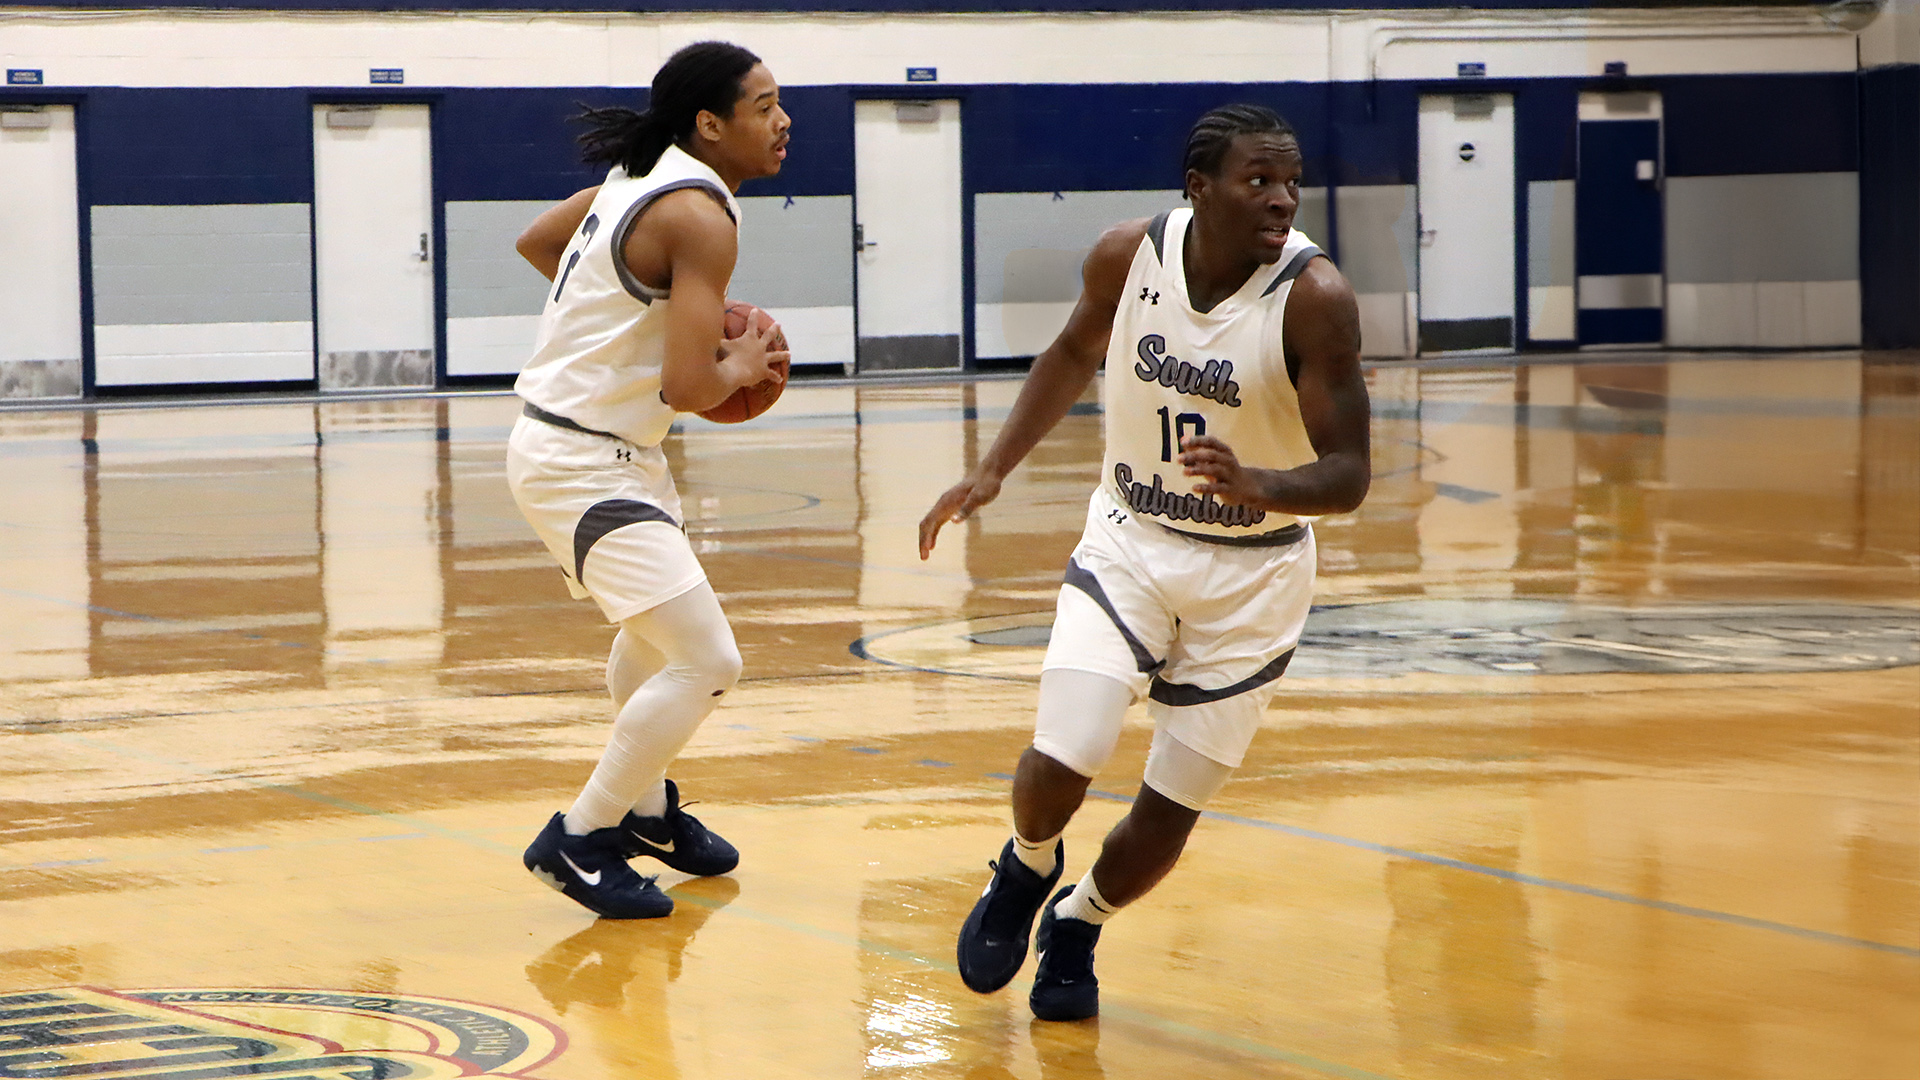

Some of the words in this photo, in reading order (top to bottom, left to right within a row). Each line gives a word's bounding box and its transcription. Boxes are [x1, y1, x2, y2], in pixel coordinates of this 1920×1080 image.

[1134, 333, 1242, 407] South
[1156, 405, 1206, 466] 10
[1114, 462, 1266, 528] Suburban
[161, 993, 454, 1015] ASSOCIATION
[442, 1015, 511, 1056] ATHLETIC
